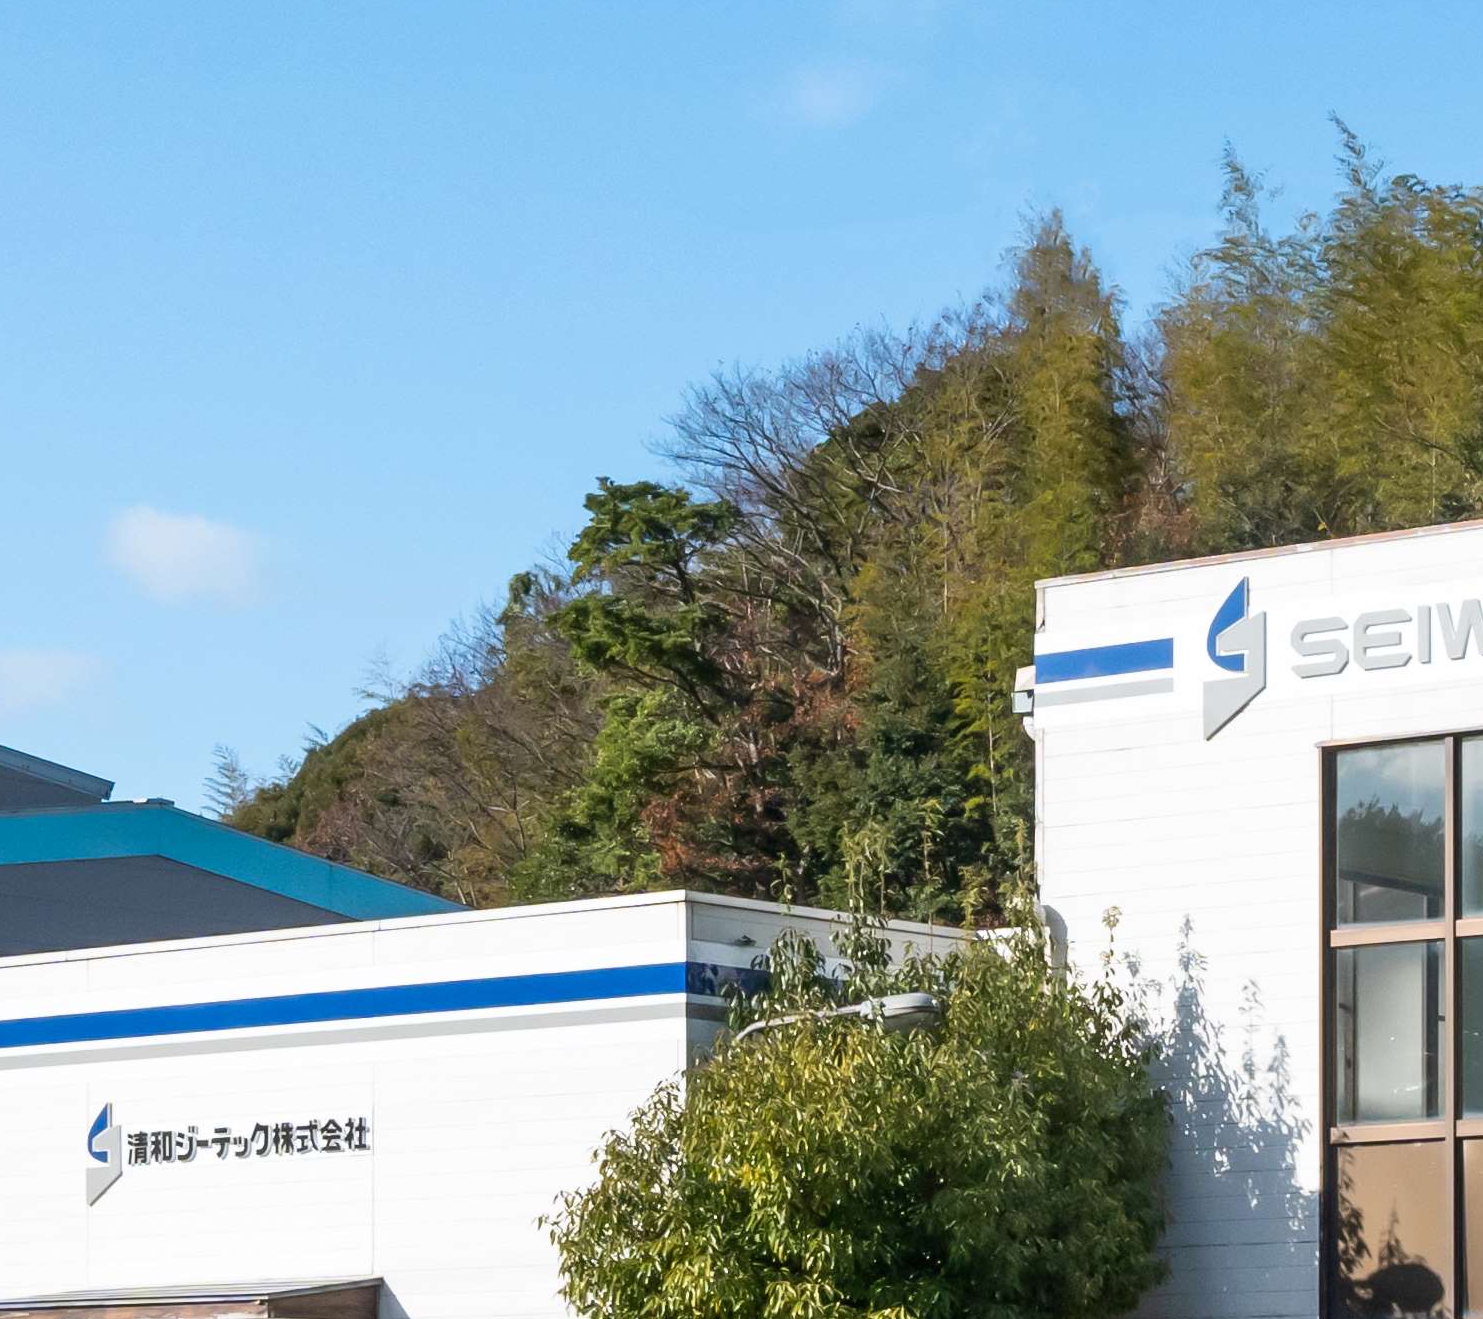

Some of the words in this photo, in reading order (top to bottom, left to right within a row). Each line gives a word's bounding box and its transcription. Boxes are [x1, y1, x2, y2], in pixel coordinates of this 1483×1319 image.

[126, 1116, 371, 1166] 清和ジーテック株式会社
